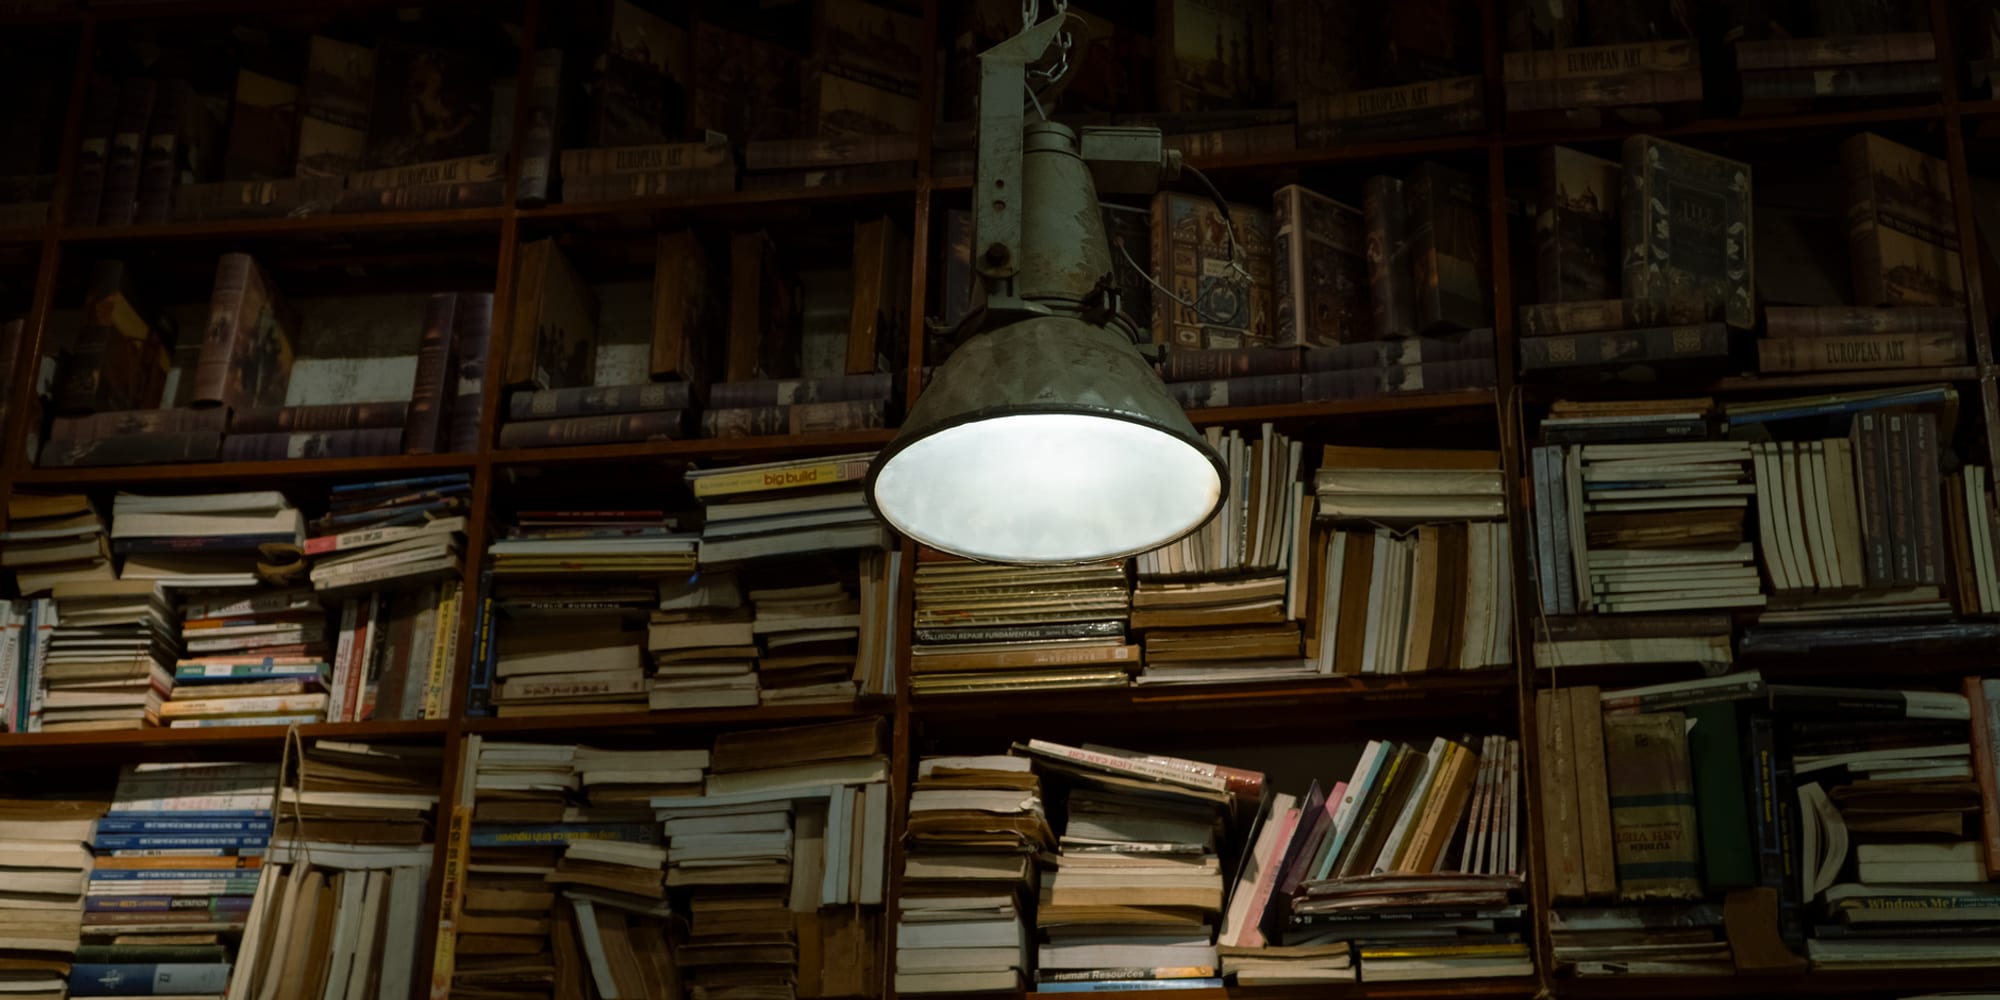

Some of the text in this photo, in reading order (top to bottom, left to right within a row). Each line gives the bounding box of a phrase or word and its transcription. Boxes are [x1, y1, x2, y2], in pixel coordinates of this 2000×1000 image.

[1567, 46, 1641, 73] EUROPEAN ART
[1357, 86, 1428, 114] EUROPEAN ART
[1826, 339, 1905, 364] EUROPEAN ART
[764, 471, 785, 486] big
[786, 469, 817, 483] build
[920, 632, 958, 641] COLLISION
[958, 631, 984, 640] REPAIR
[985, 629, 1040, 639] FUNDAMENTALS
[170, 899, 209, 908] DICTATION
[1868, 897, 1928, 910] Windows
[1054, 969, 1145, 981] Human Resources
